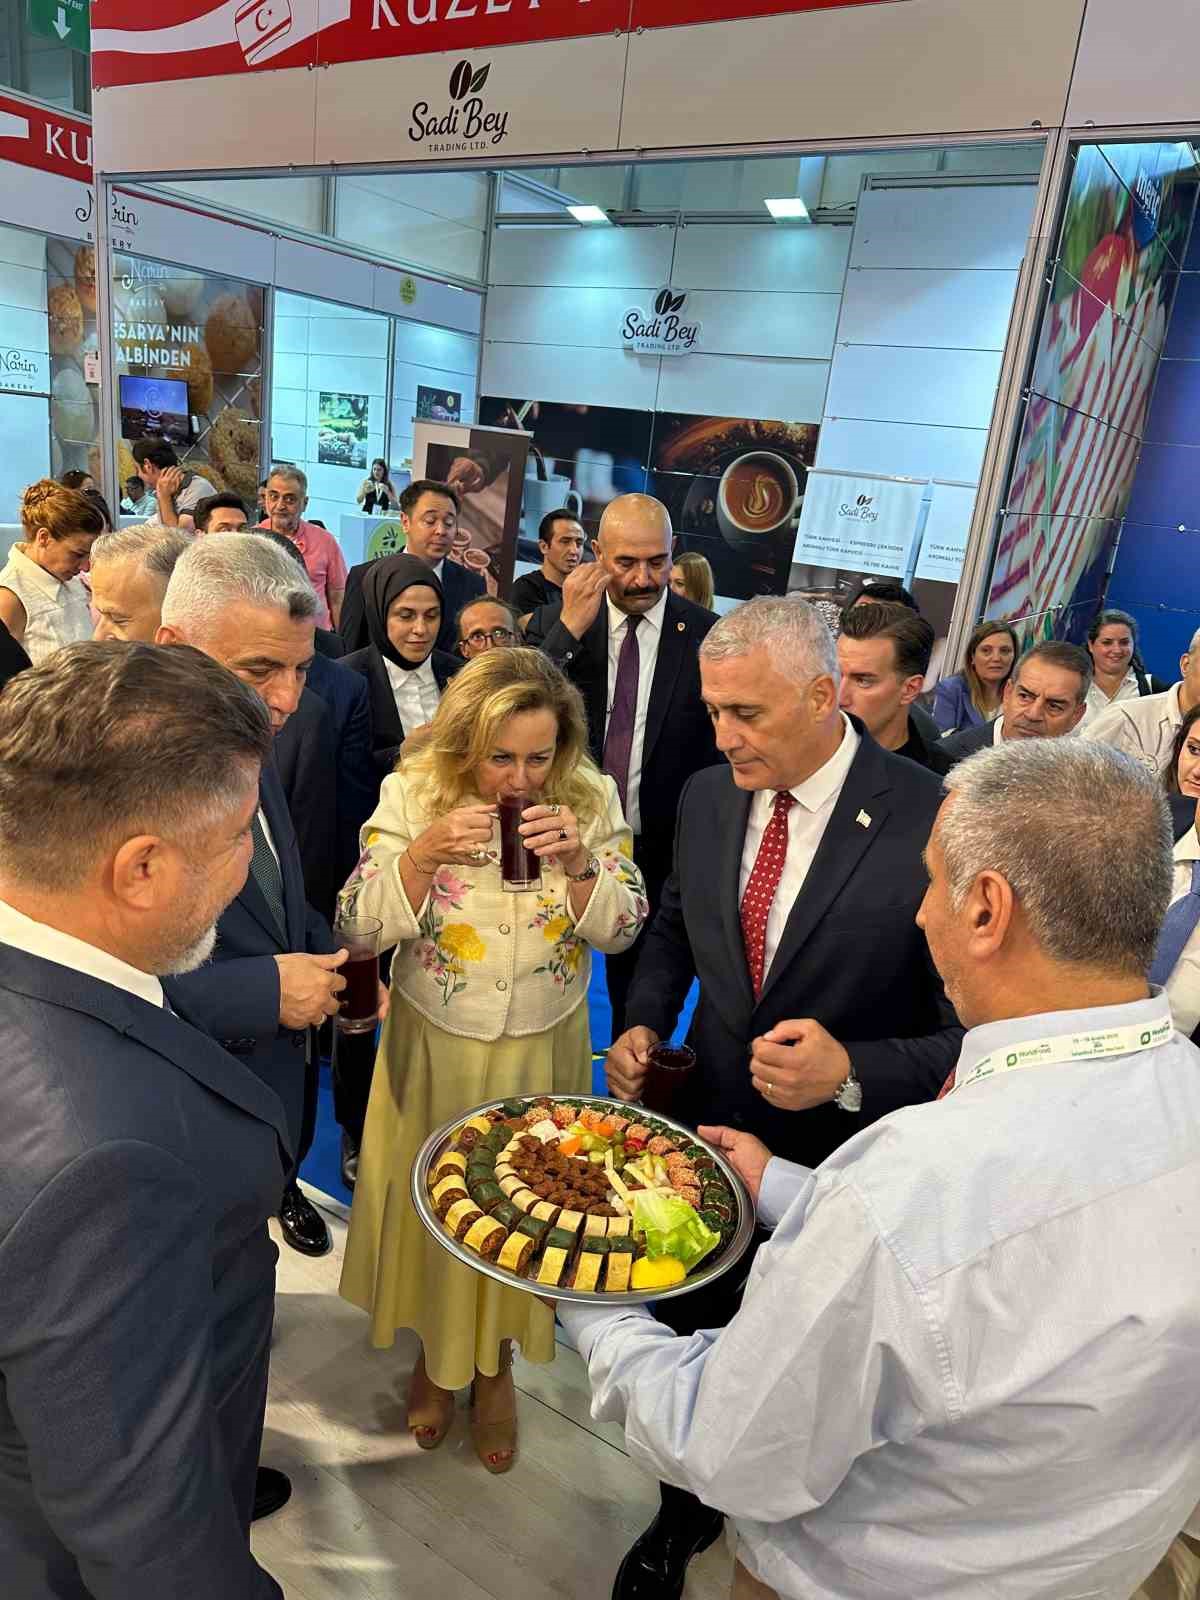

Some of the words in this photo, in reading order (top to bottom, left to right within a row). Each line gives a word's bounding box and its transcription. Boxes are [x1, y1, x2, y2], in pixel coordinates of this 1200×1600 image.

[408, 101, 458, 142] Sadi
[462, 97, 509, 144] Bey
[428, 142, 467, 153] TRADING
[622, 312, 661, 340] Sadi
[663, 315, 698, 348] Bey
[838, 503, 859, 517] Sadi
[860, 506, 879, 522] Bey
